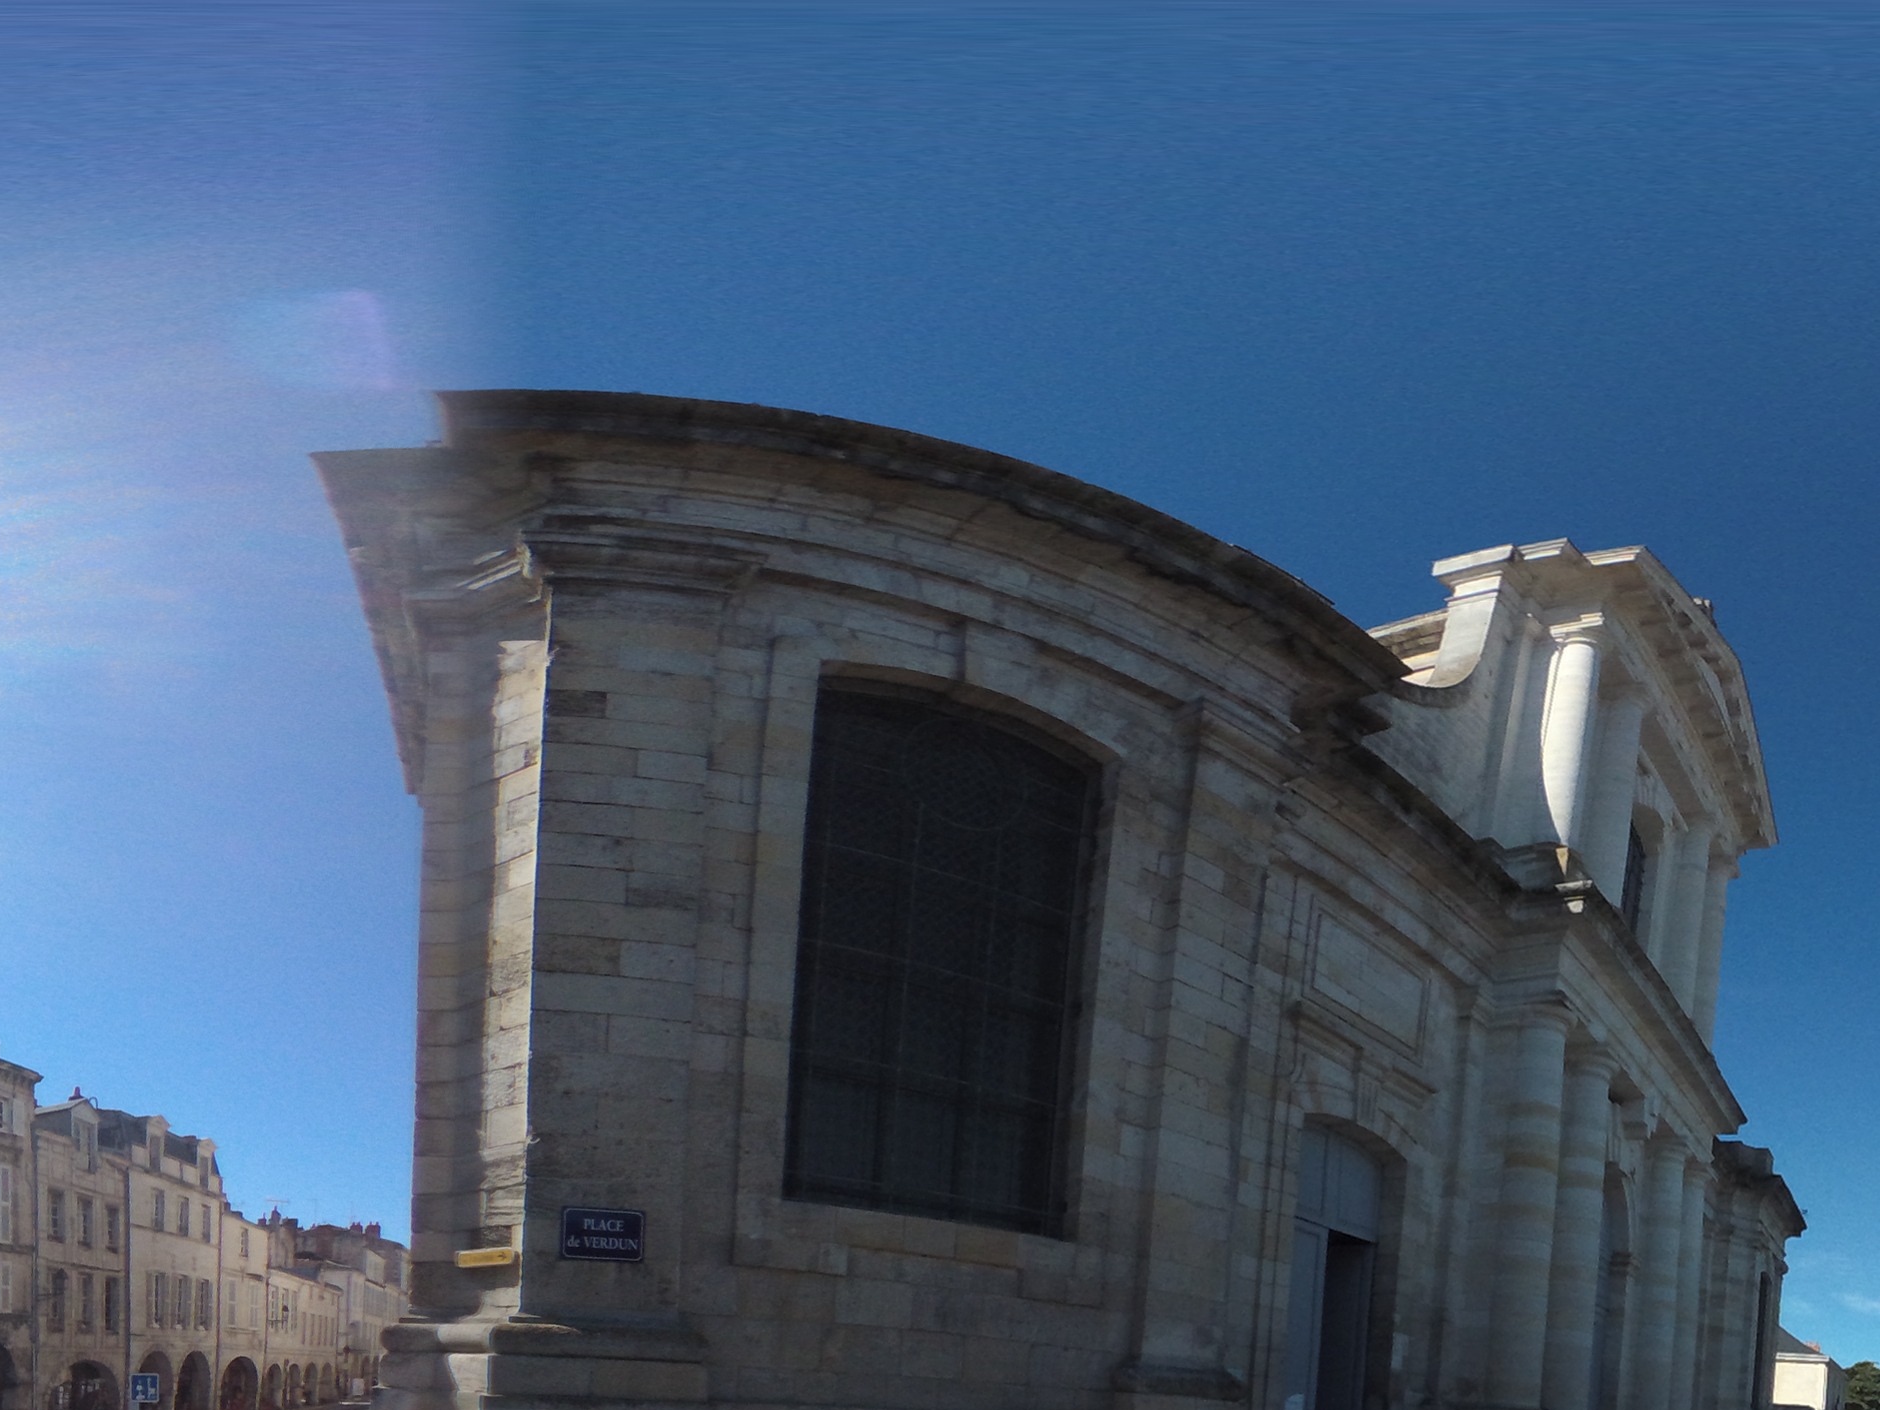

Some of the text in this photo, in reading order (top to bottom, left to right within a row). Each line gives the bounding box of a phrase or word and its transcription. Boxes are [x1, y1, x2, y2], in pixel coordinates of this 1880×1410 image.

[583, 1219, 624, 1233] PLACE
[567, 1236, 639, 1251] de VERDUN
